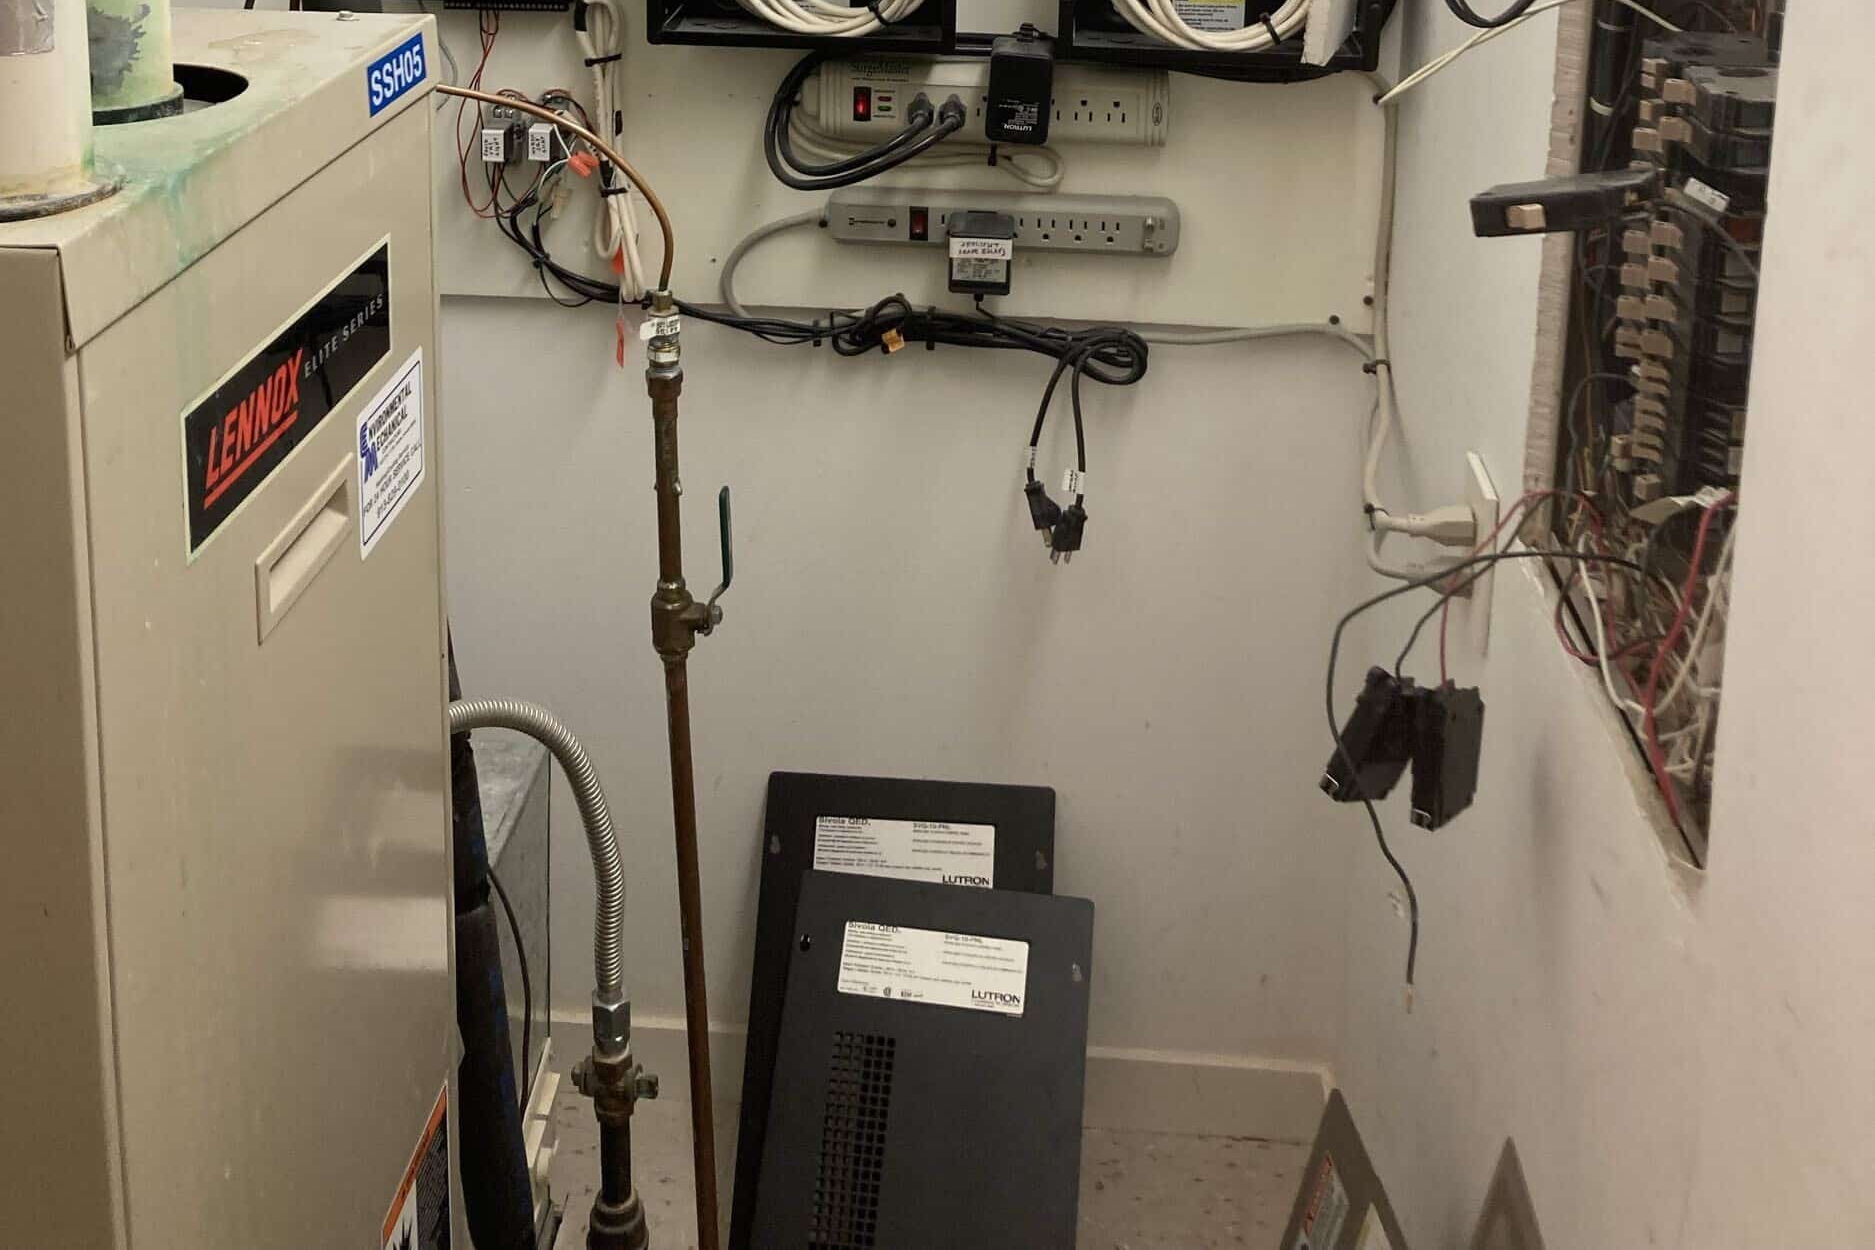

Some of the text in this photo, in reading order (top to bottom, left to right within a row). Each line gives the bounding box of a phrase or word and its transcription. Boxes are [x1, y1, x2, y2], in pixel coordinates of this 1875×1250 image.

[371, 43, 422, 106] SSH05
[1003, 123, 1033, 132] LUTRON
[205, 293, 384, 490] LENNOX ELITE SERIES
[942, 874, 990, 886] LUTRON
[971, 989, 1021, 1005] LUTRON
